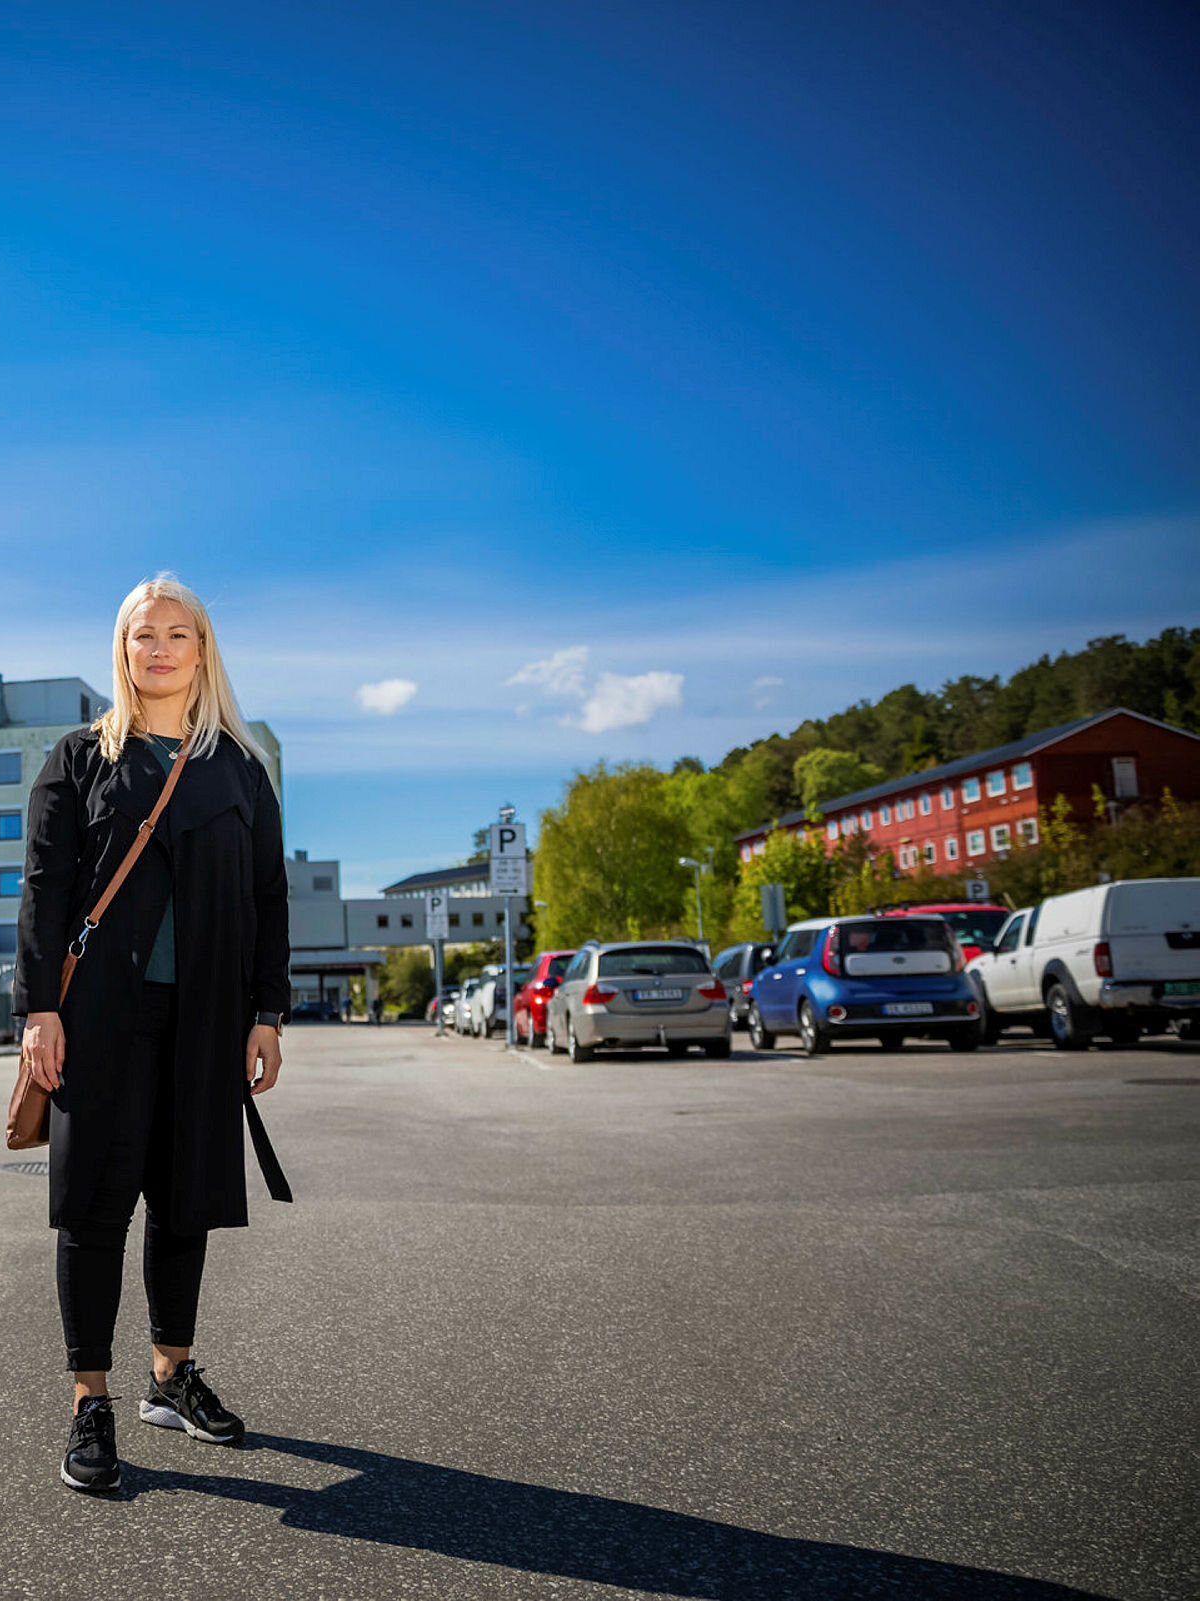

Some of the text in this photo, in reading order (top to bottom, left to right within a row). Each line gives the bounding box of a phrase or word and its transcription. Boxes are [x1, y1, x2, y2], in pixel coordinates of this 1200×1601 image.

[500, 828, 516, 853] P
[972, 884, 984, 898] P
[431, 897, 441, 911] P
